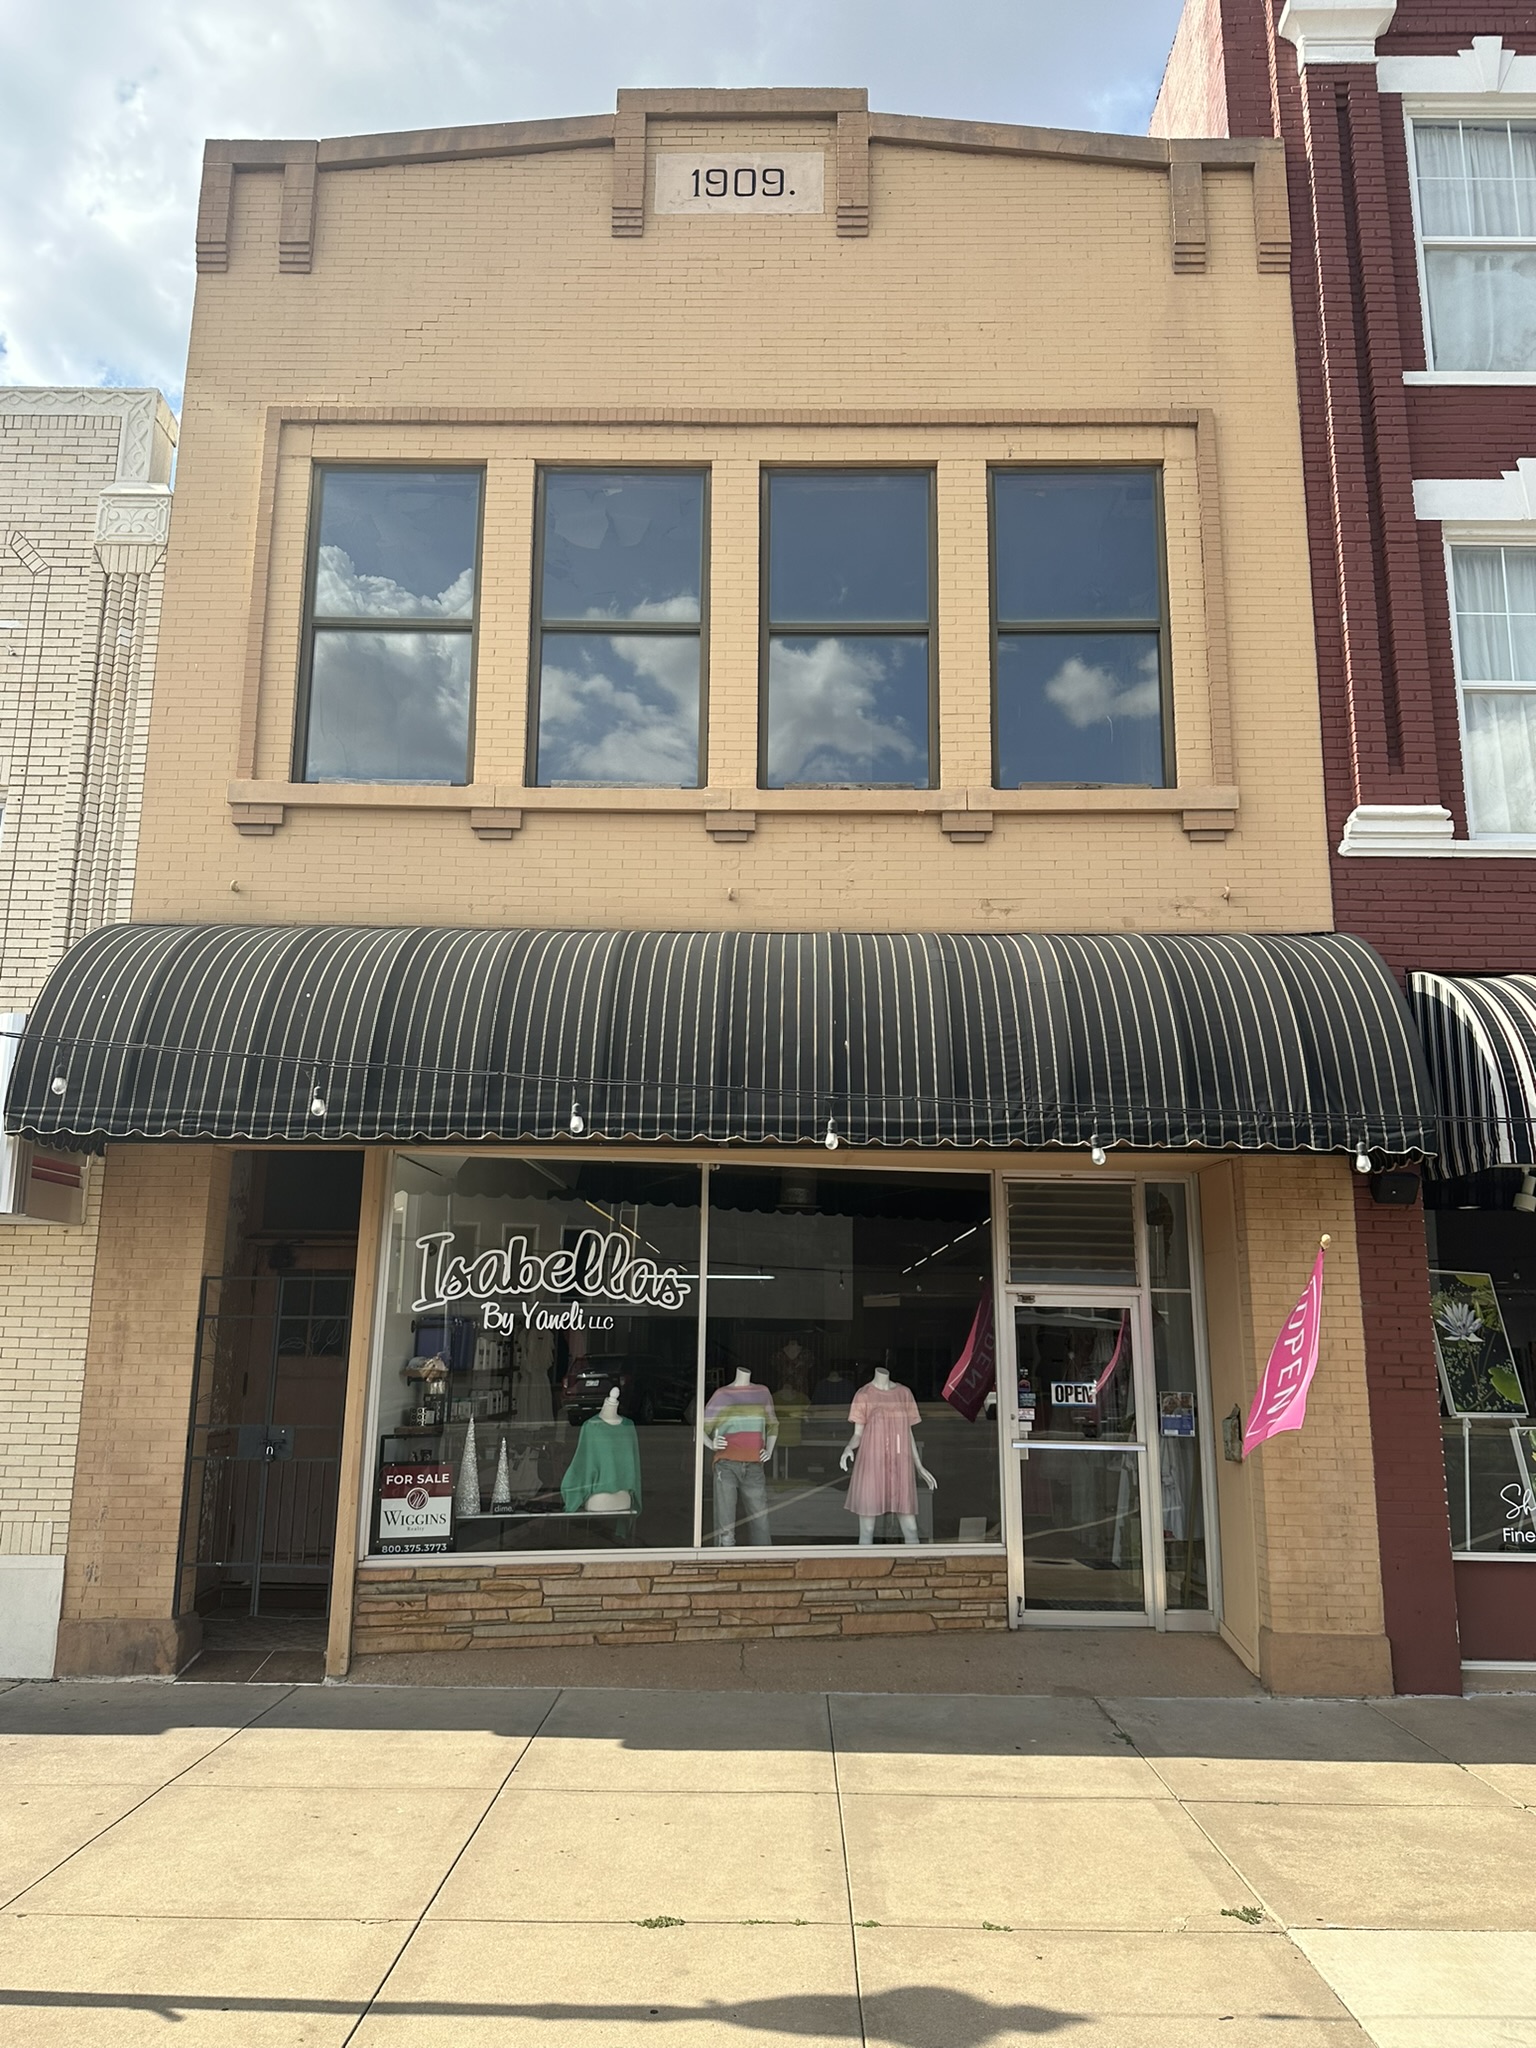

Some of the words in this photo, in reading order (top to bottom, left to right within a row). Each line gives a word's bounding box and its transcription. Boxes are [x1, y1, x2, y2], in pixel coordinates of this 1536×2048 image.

[691, 168, 796, 197] 1909.
[411, 1229, 691, 1311] Isabellas
[481, 1301, 515, 1336] By
[522, 1301, 585, 1330] Yaneli
[588, 1316, 614, 1330] LLC
[1266, 1301, 1308, 1415] OPEN
[1055, 1384, 1093, 1404] OPEN
[386, 1474, 413, 1485] FOR
[417, 1473, 450, 1484] SALE
[383, 1509, 447, 1527] WIGGINS
[1503, 1527, 1536, 1543] Fine
[381, 1543, 447, 1553] 800.375.3773
